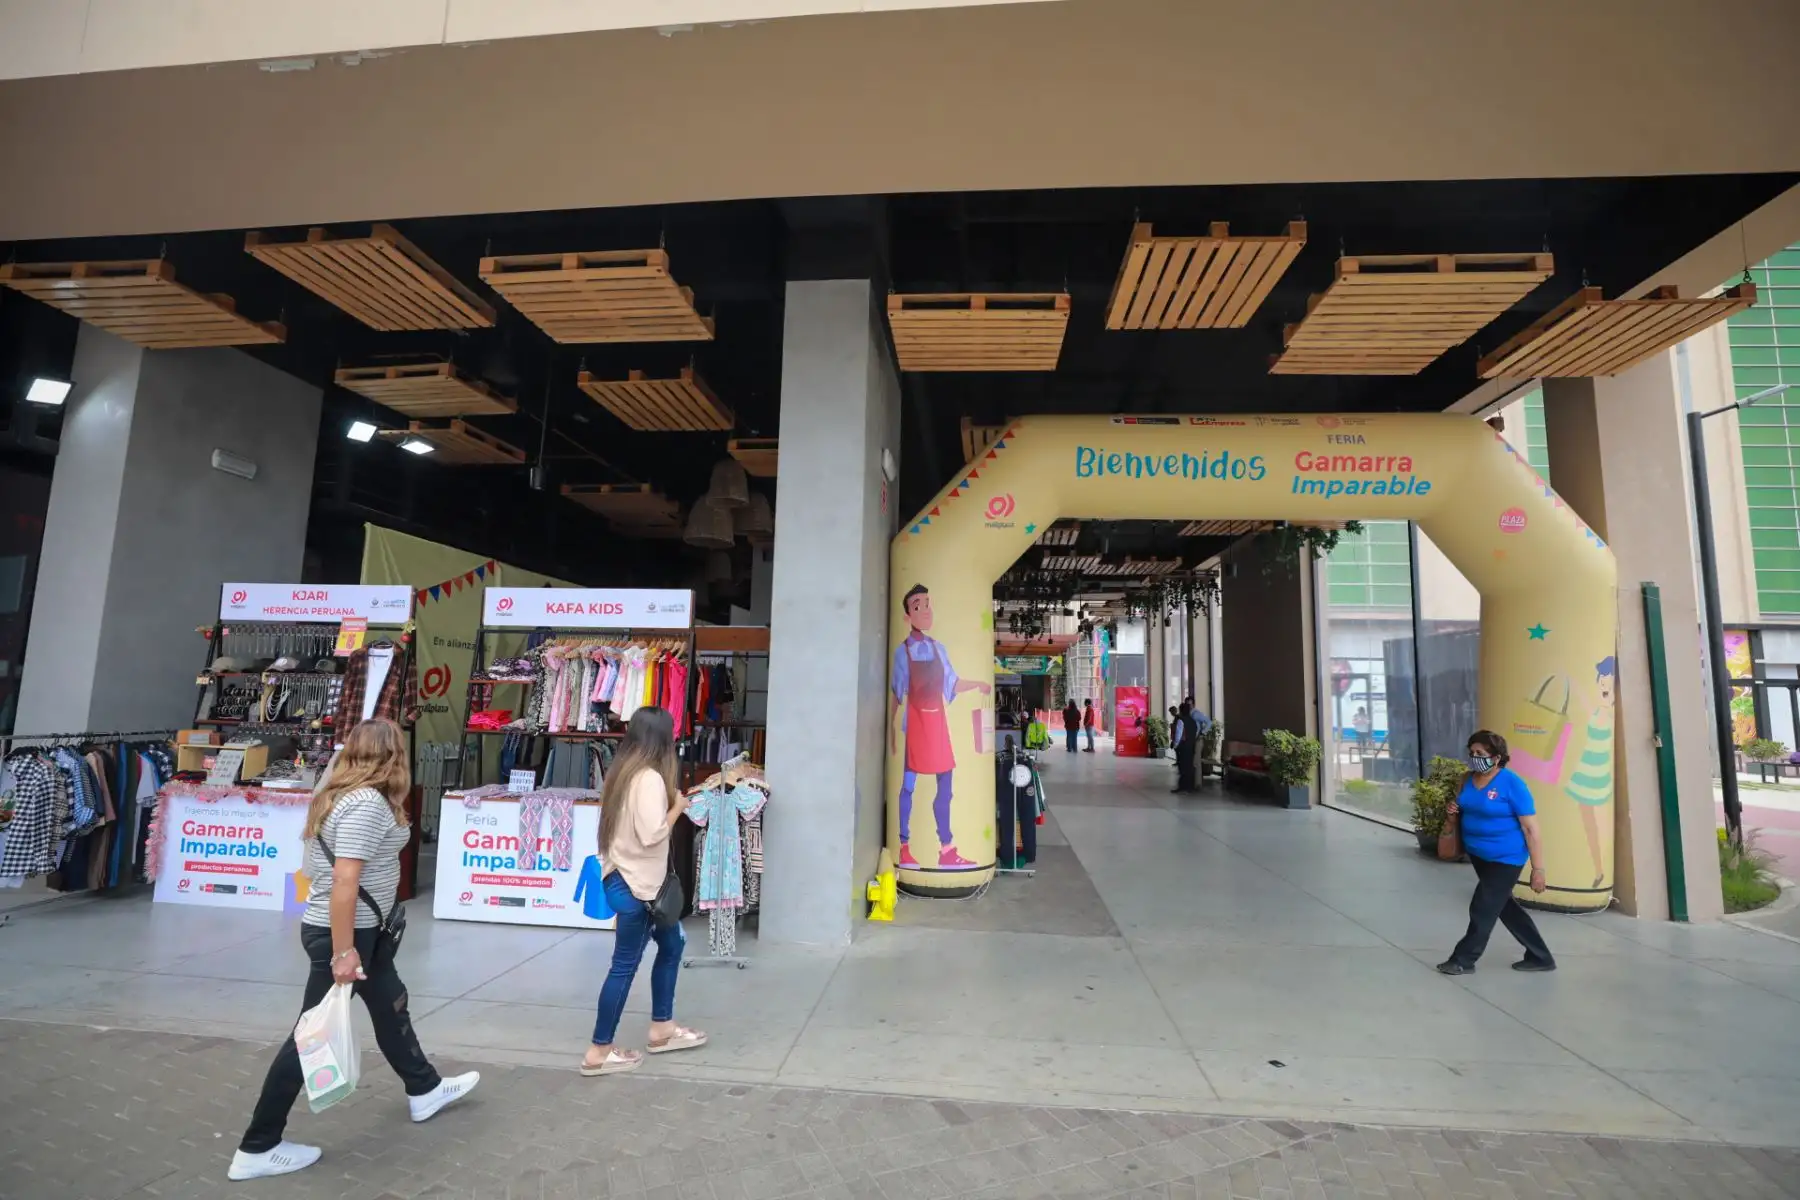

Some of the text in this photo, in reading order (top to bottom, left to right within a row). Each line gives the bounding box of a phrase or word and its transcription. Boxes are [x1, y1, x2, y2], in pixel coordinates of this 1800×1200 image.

[1327, 434, 1366, 445] FERIA
[1075, 446, 1267, 481] Bienvenidos
[1294, 451, 1413, 473] Gamarra
[1291, 476, 1432, 499] Imparable
[292, 590, 329, 601] KJARI
[262, 606, 356, 616] HERENCIA PERUANA
[546, 602, 623, 615] KAFA KIDS
[433, 636, 445, 646] En
[184, 806, 220, 816] Traemos
[231, 809, 257, 819] mejor
[465, 813, 498, 827] Feria
[182, 820, 264, 839] Gamarra
[463, 830, 554, 852] Gamrr
[180, 838, 278, 858] Imparable
[463, 851, 569, 872] Impab
[190, 863, 253, 874] productos peruanos
[473, 875, 501, 884] prendas
